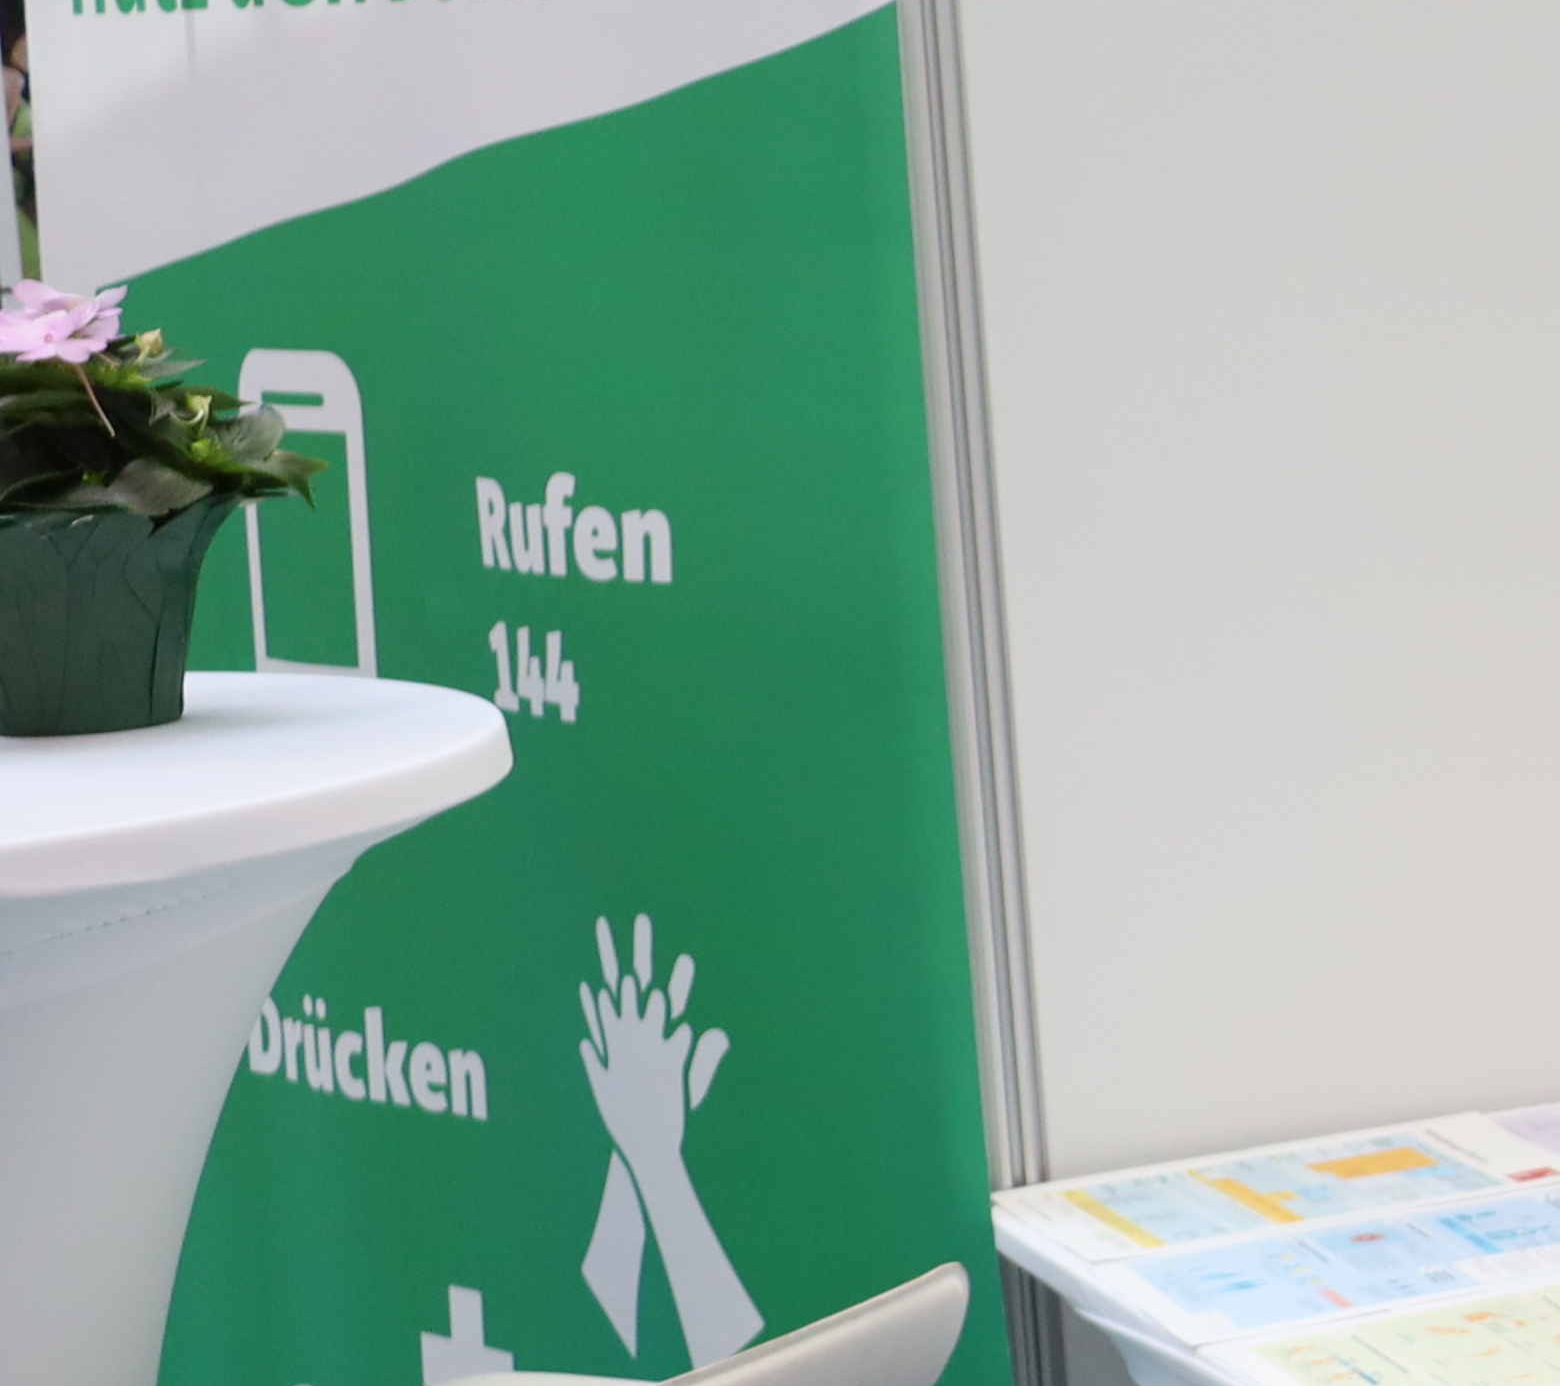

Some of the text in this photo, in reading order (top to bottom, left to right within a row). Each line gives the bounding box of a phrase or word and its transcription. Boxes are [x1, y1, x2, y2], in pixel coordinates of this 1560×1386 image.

[475, 471, 673, 584] Rufen
[488, 619, 580, 724] 144
[248, 993, 488, 1122] Drücken
